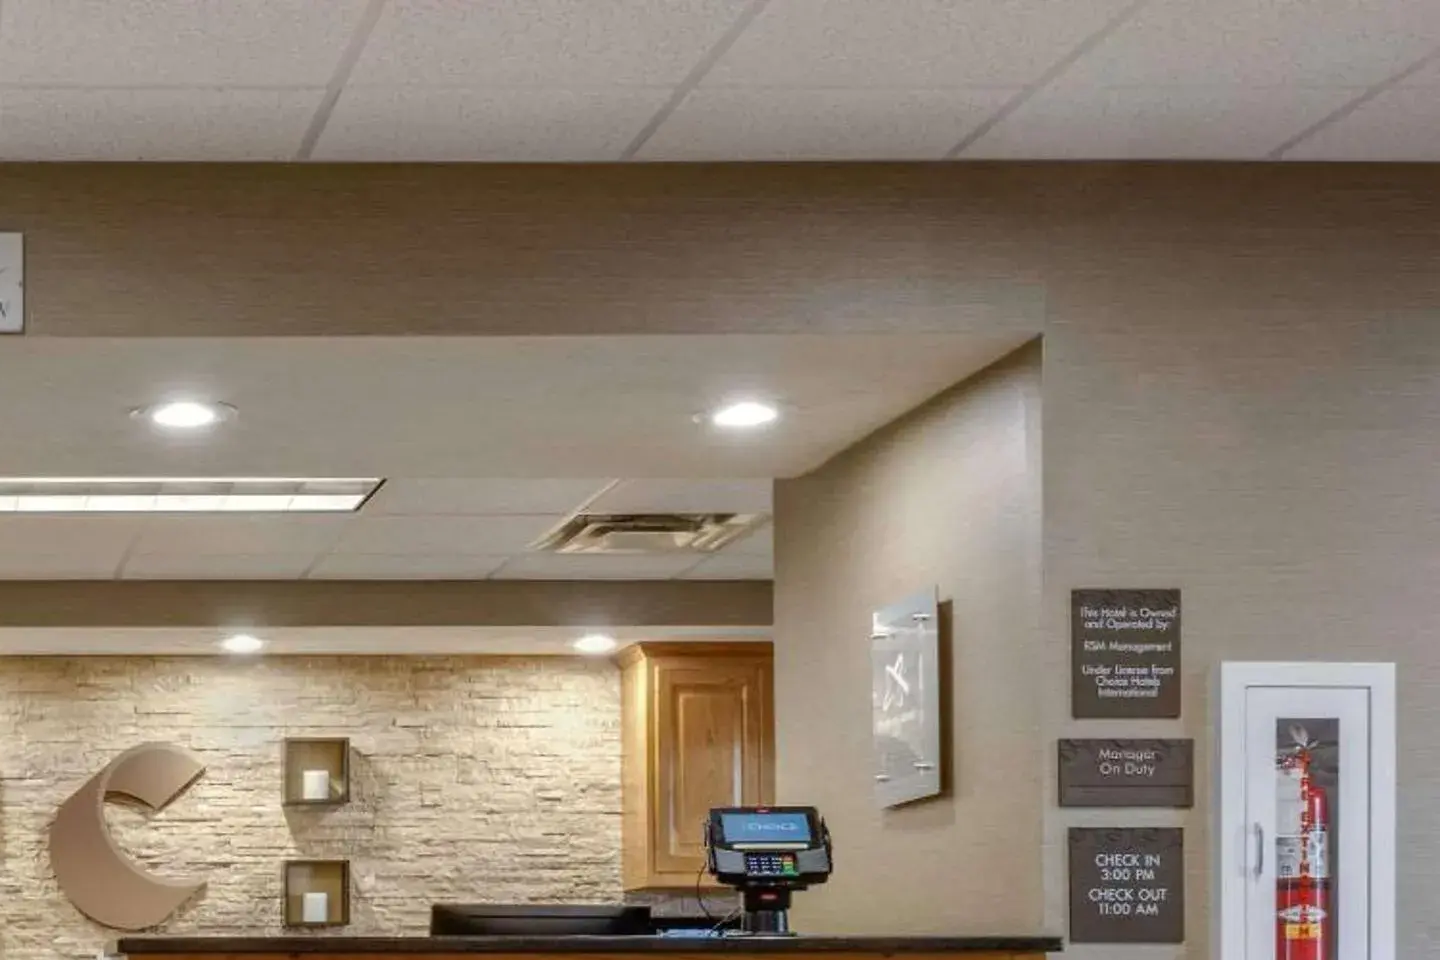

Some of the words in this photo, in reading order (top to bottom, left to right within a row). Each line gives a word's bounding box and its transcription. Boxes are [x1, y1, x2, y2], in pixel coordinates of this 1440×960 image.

[1101, 606, 1127, 618] Hotel
[1140, 606, 1176, 618] Owned
[1084, 619, 1104, 629] and
[1106, 619, 1153, 631] Operated
[1108, 640, 1172, 654] Management
[1082, 664, 1112, 675] Under
[1115, 664, 1148, 675] License
[1151, 664, 1174, 675] from
[1096, 675, 1129, 686] Choice
[1130, 675, 1161, 686] Hotels
[1097, 686, 1159, 698] International
[1098, 748, 1156, 762] Manager
[1099, 762, 1121, 775] On
[1124, 762, 1156, 777] Duty
[1095, 853, 1142, 867] CHECK
[1145, 853, 1161, 867] IN
[1100, 868, 1131, 881] 3:00
[1135, 868, 1155, 881] PM
[1088, 888, 1134, 901] CHECK
[1138, 888, 1168, 901] OUT
[1098, 903, 1131, 916] 11:00
[1135, 903, 1159, 916] AM
